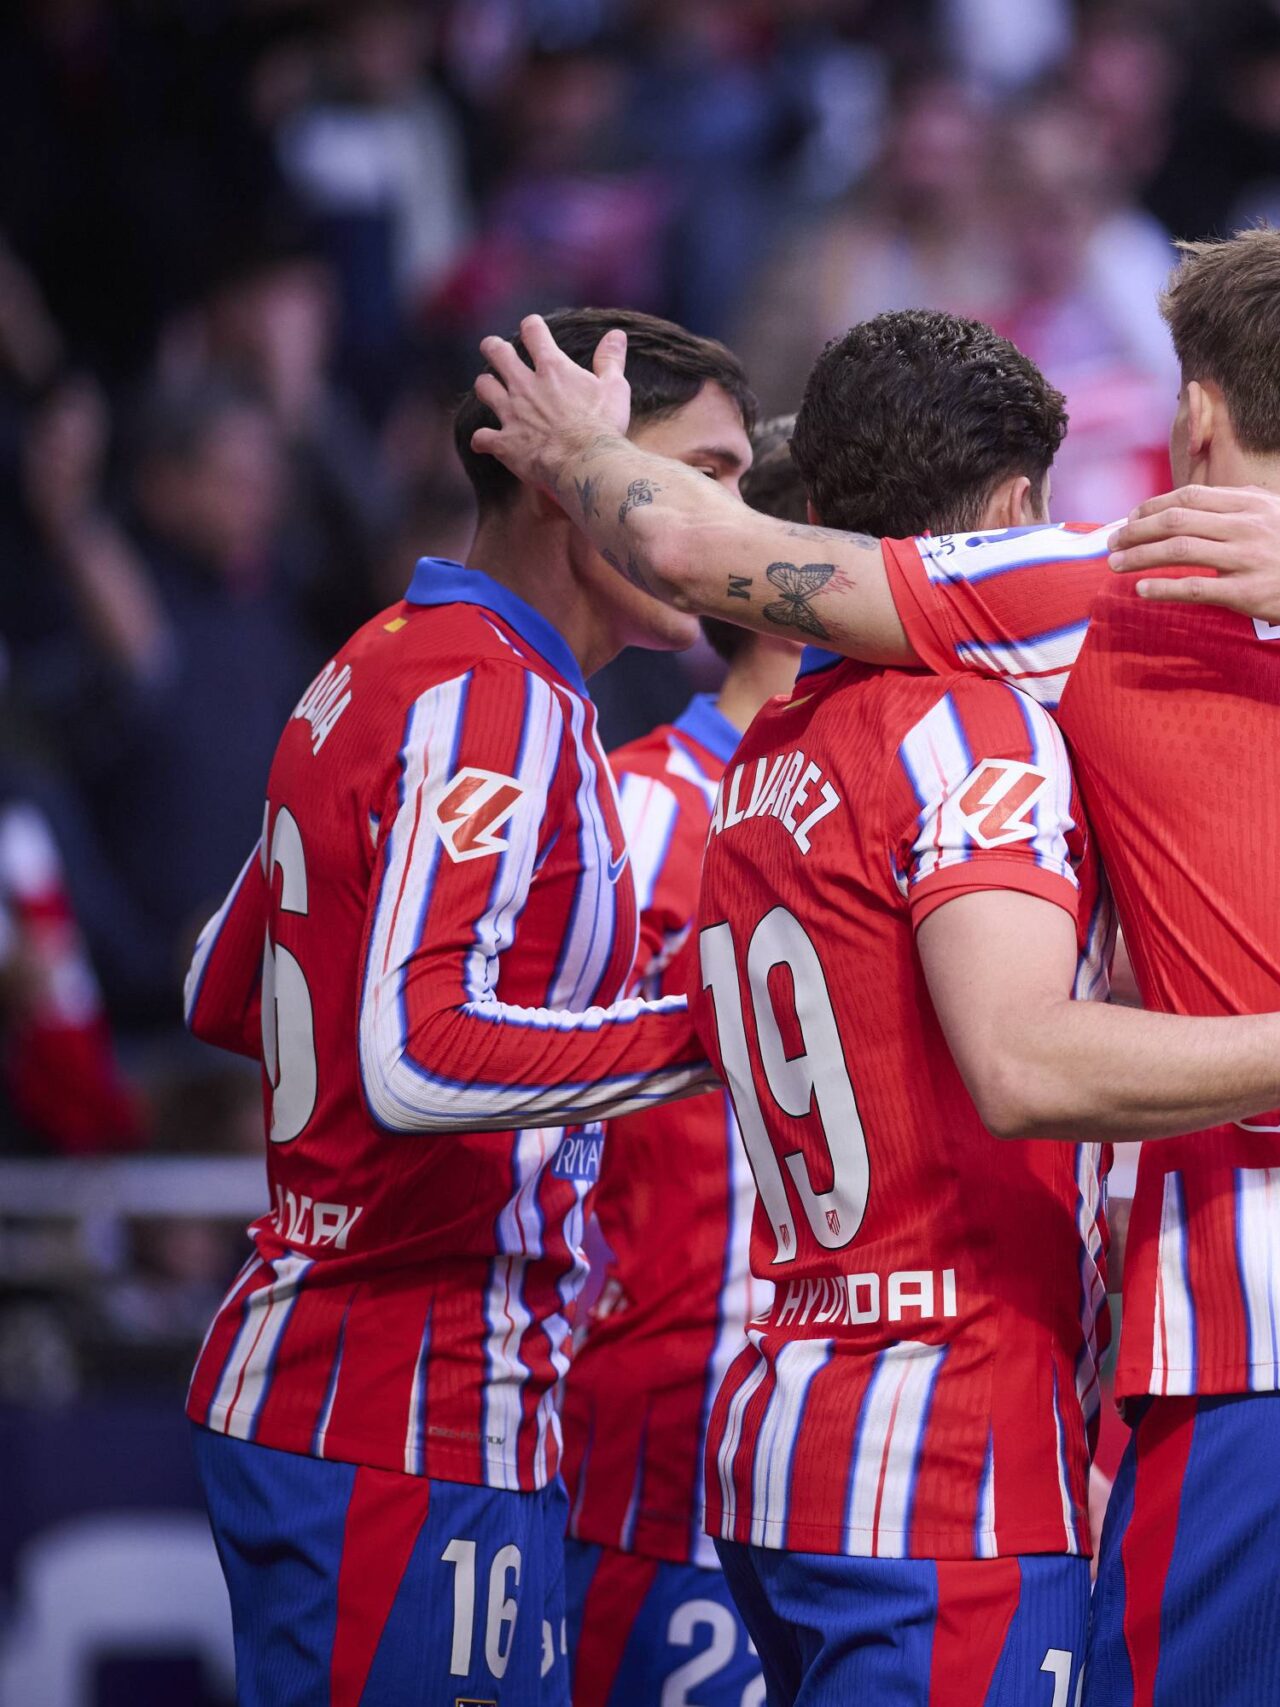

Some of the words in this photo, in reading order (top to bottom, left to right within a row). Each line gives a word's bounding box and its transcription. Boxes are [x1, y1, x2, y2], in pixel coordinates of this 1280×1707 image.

[700, 905, 871, 1265] 19
[441, 1538, 522, 1680] 16
[661, 1598, 767, 1707] 2
